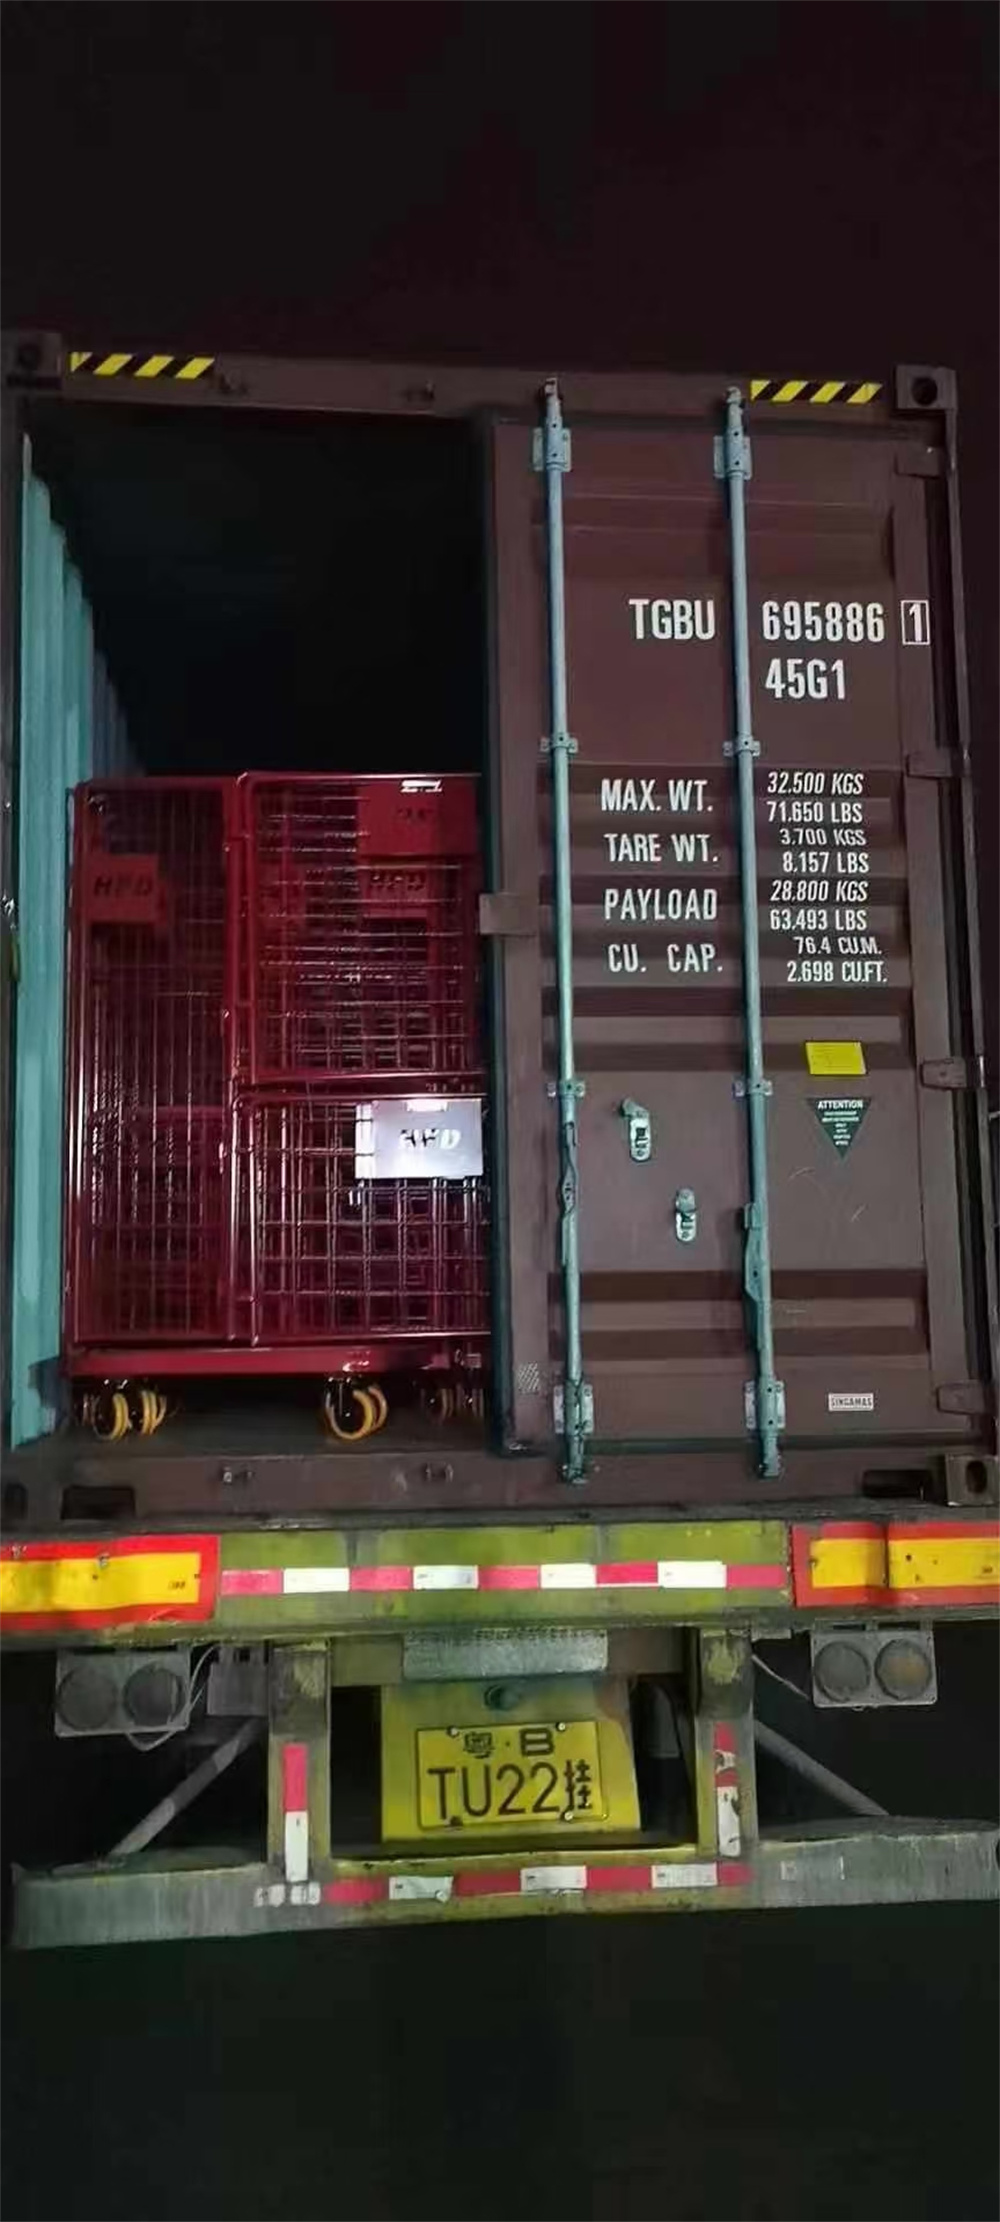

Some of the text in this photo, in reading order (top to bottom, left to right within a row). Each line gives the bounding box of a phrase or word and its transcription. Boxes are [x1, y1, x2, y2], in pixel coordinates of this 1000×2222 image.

[628, 598, 717, 641] TGBU
[761, 600, 886, 643] 695886
[765, 658, 846, 699] 45G1
[600, 779, 714, 811] MAX. WT.
[831, 773, 864, 795] KGS
[830, 802, 863, 824] LBS
[604, 833, 719, 863] TARE WT.
[833, 829, 867, 847] KGS
[837, 852, 870, 874] LBS
[836, 881, 869, 902] KGS
[604, 888, 718, 920] PAYLOAD
[835, 910, 868, 931] LBS
[793, 937, 832, 955] 76.4
[608, 944, 723, 973] CU. CAP.
[817, 1099, 864, 1110] ATTENTION
